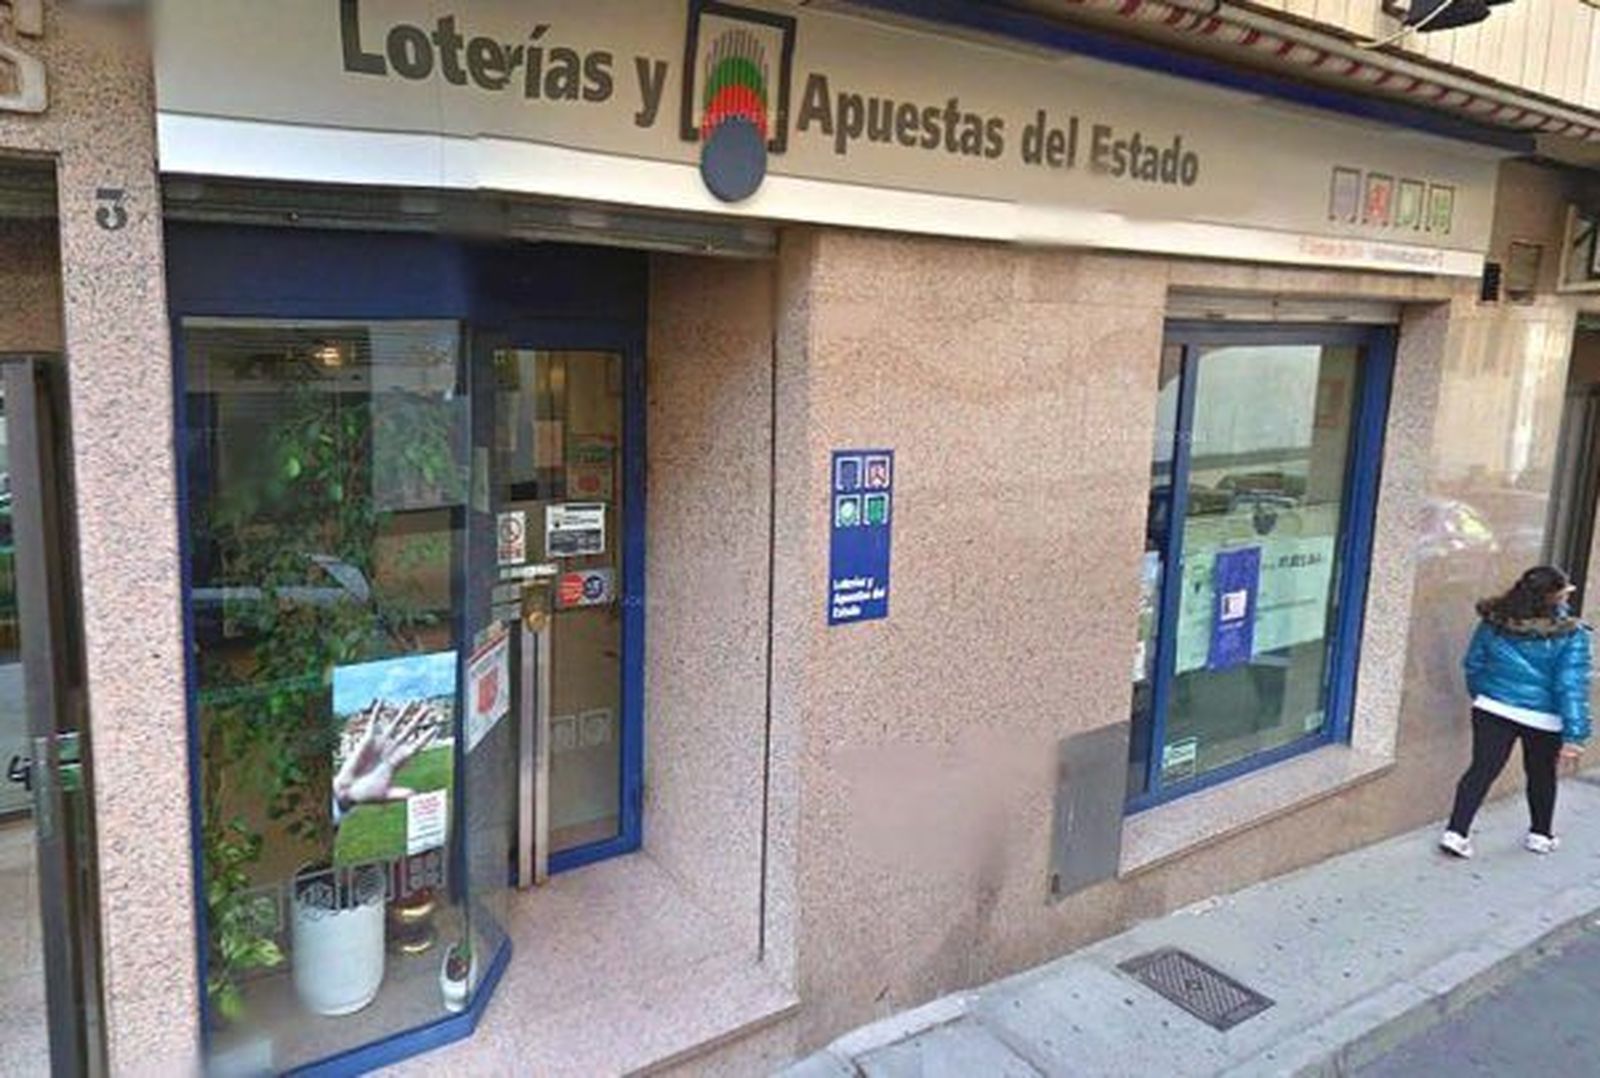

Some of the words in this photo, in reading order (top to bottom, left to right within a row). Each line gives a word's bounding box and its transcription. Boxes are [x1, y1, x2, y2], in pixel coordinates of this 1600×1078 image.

[340, 0, 613, 103] Loterías
[635, 56, 668, 127] y
[796, 72, 1005, 158] Apuestas
[1021, 109, 1079, 168] del
[1090, 124, 1199, 186] Estado
[95, 187, 128, 230] 3
